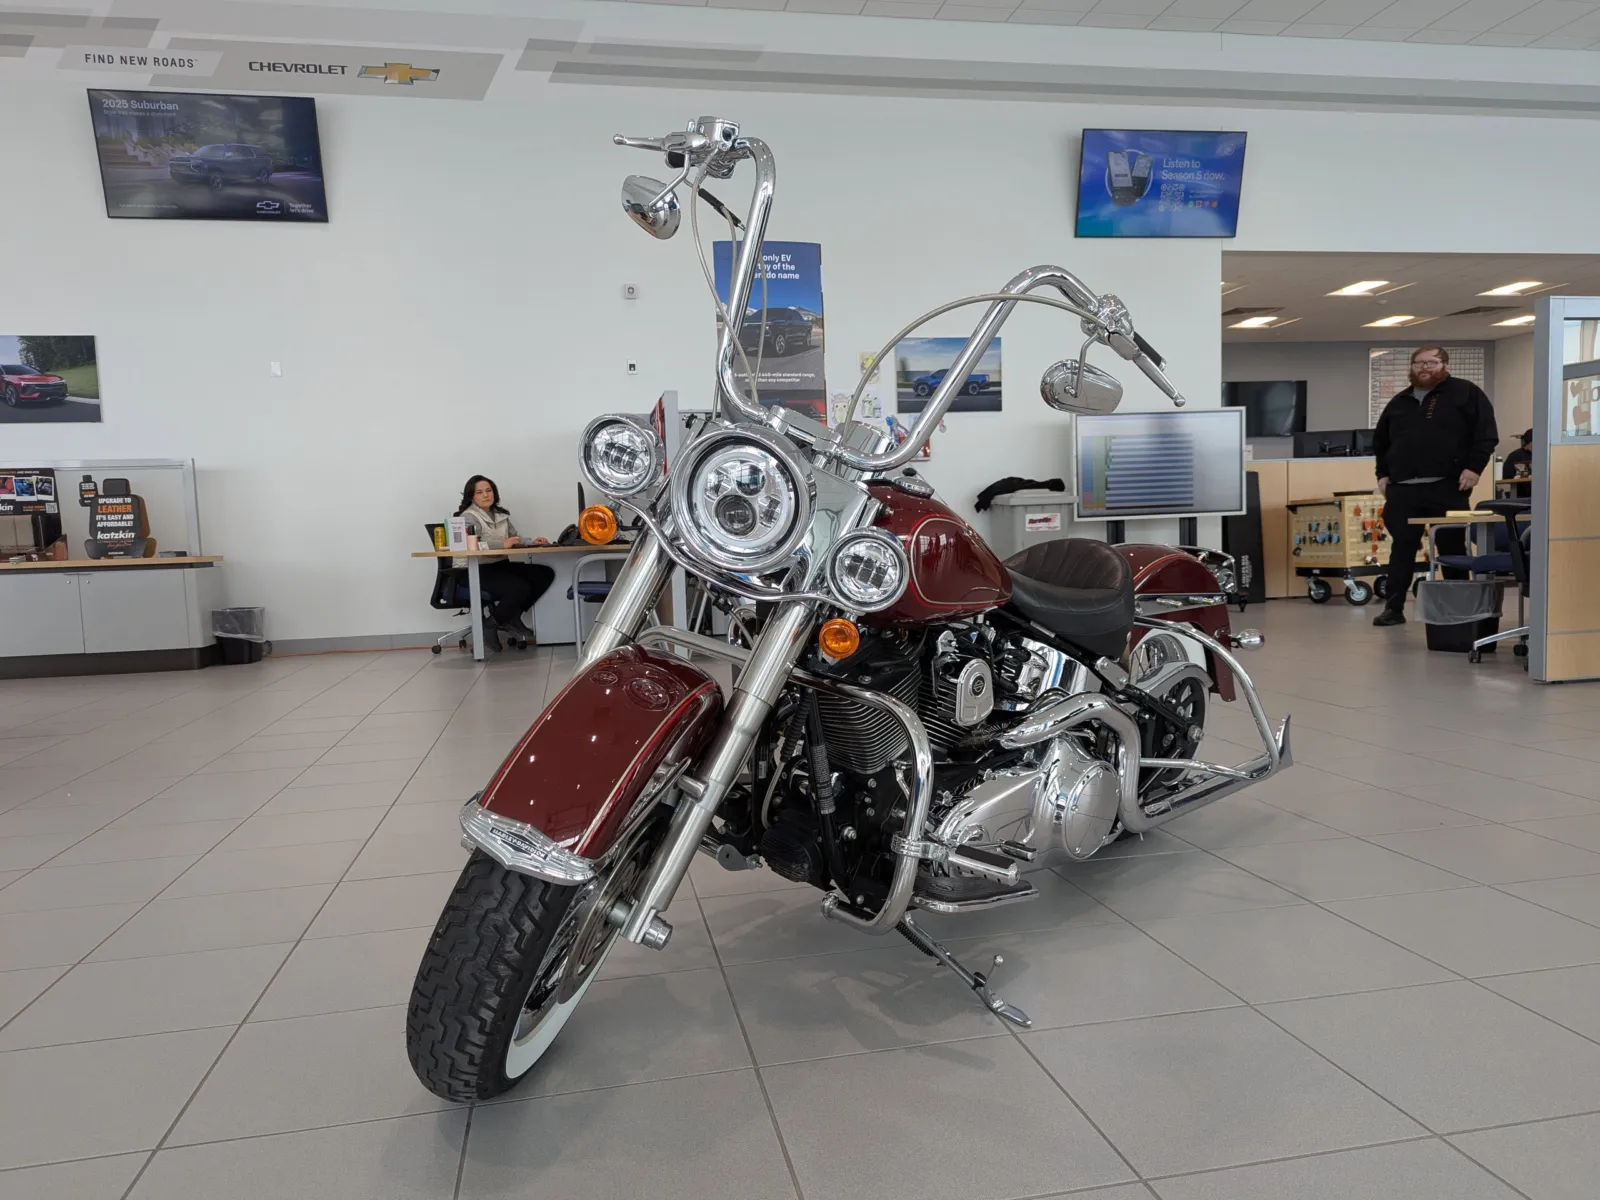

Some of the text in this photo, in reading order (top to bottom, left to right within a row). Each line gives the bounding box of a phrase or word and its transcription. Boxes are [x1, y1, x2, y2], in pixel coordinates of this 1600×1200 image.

[84, 53, 115, 65] FIND
[120, 55, 148, 66] NEW
[248, 61, 348, 75] CHEVROLET
[102, 99, 179, 111] 2025 Suburban
[1163, 158, 1201, 168] Listen to
[1161, 169, 1225, 181] Season 5 now.
[762, 253, 792, 263] only EV
[772, 262, 781, 270] of
[782, 263, 796, 271] the
[777, 271, 800, 280] name
[97, 504, 132, 513] LEATHER
[97, 520, 134, 528] AFFORDABLE!
[96, 530, 136, 540] katzkin
